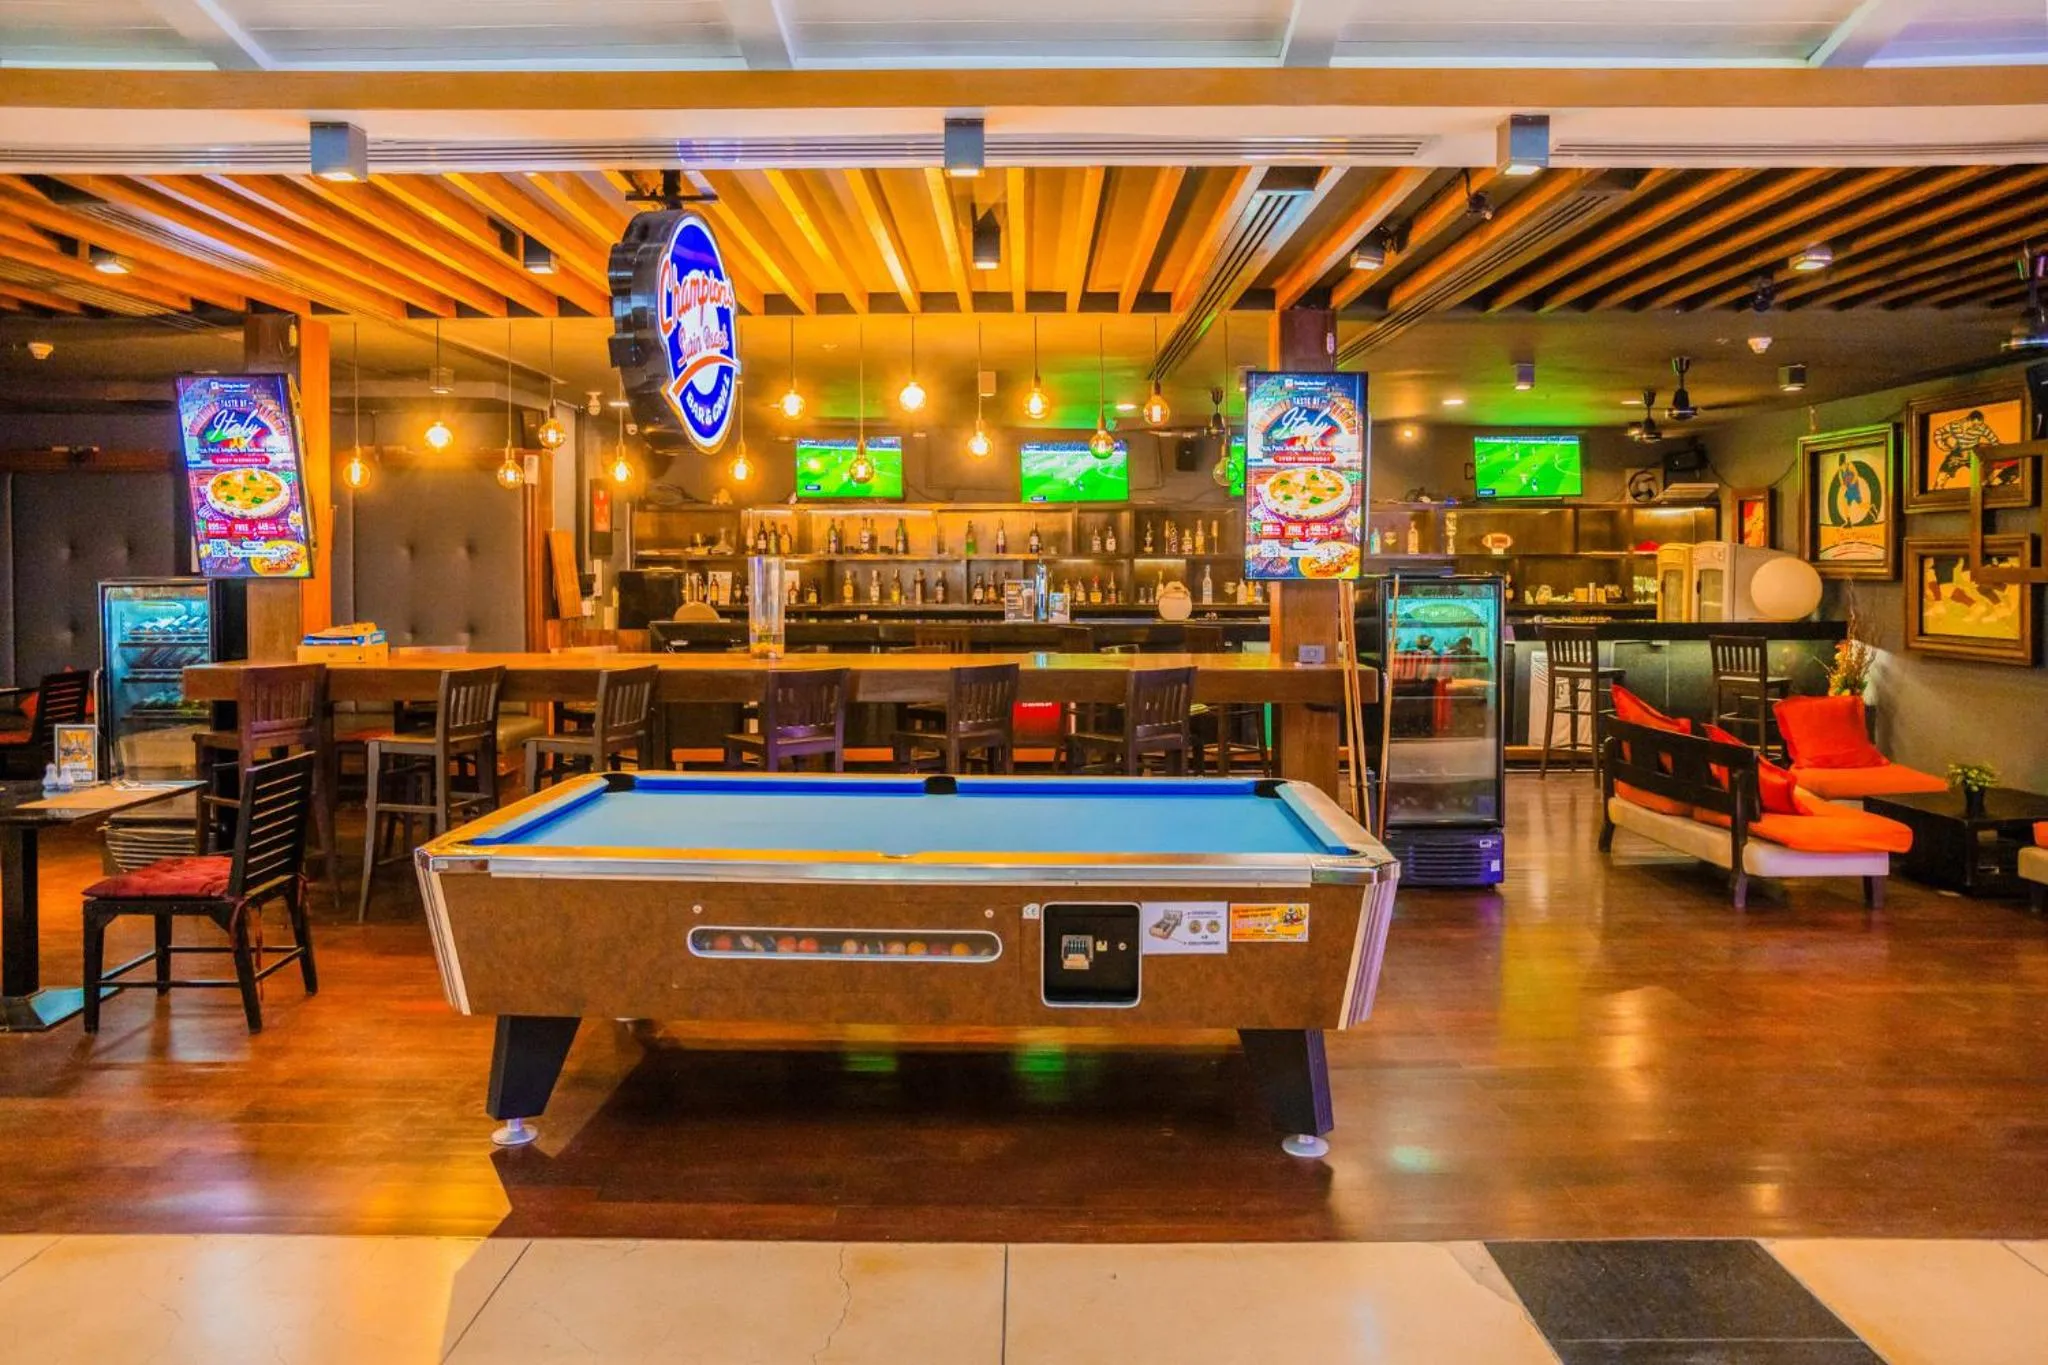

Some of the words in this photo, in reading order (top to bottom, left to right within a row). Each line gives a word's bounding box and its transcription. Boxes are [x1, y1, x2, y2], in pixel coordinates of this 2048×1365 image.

[659, 258, 735, 334] Champions
[208, 409, 261, 446] Italy
[1279, 406, 1331, 445] Italy
